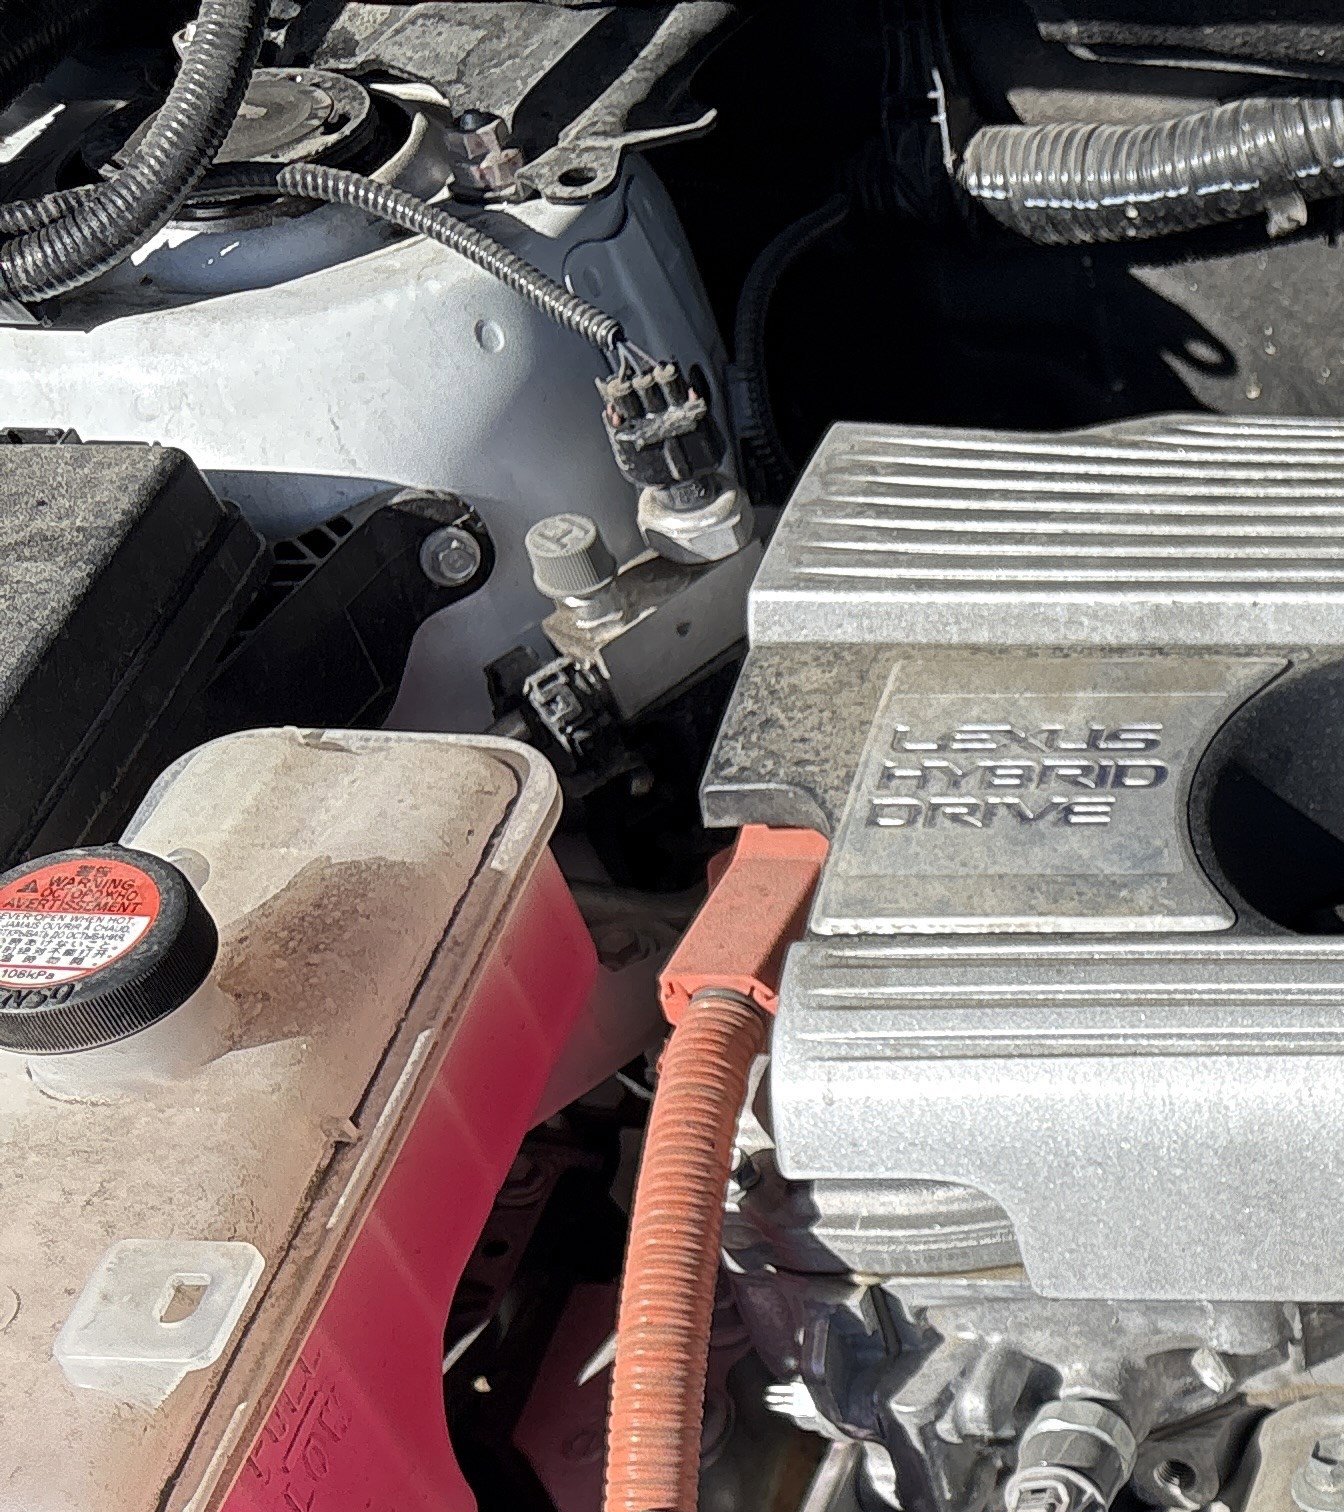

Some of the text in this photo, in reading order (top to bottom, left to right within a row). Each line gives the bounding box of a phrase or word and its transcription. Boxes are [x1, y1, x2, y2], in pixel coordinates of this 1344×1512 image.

[891, 721, 1164, 753] LEXUS
[877, 757, 1170, 790] HYBRID
[866, 795, 1116, 829] DRIVE
[49, 875, 136, 890] WARNING
[0, 912, 34, 921] EVER
[34, 912, 68, 922] OPEN
[70, 914, 104, 924] WHEN
[3, 898, 142, 914] AVERTISSEMENT
